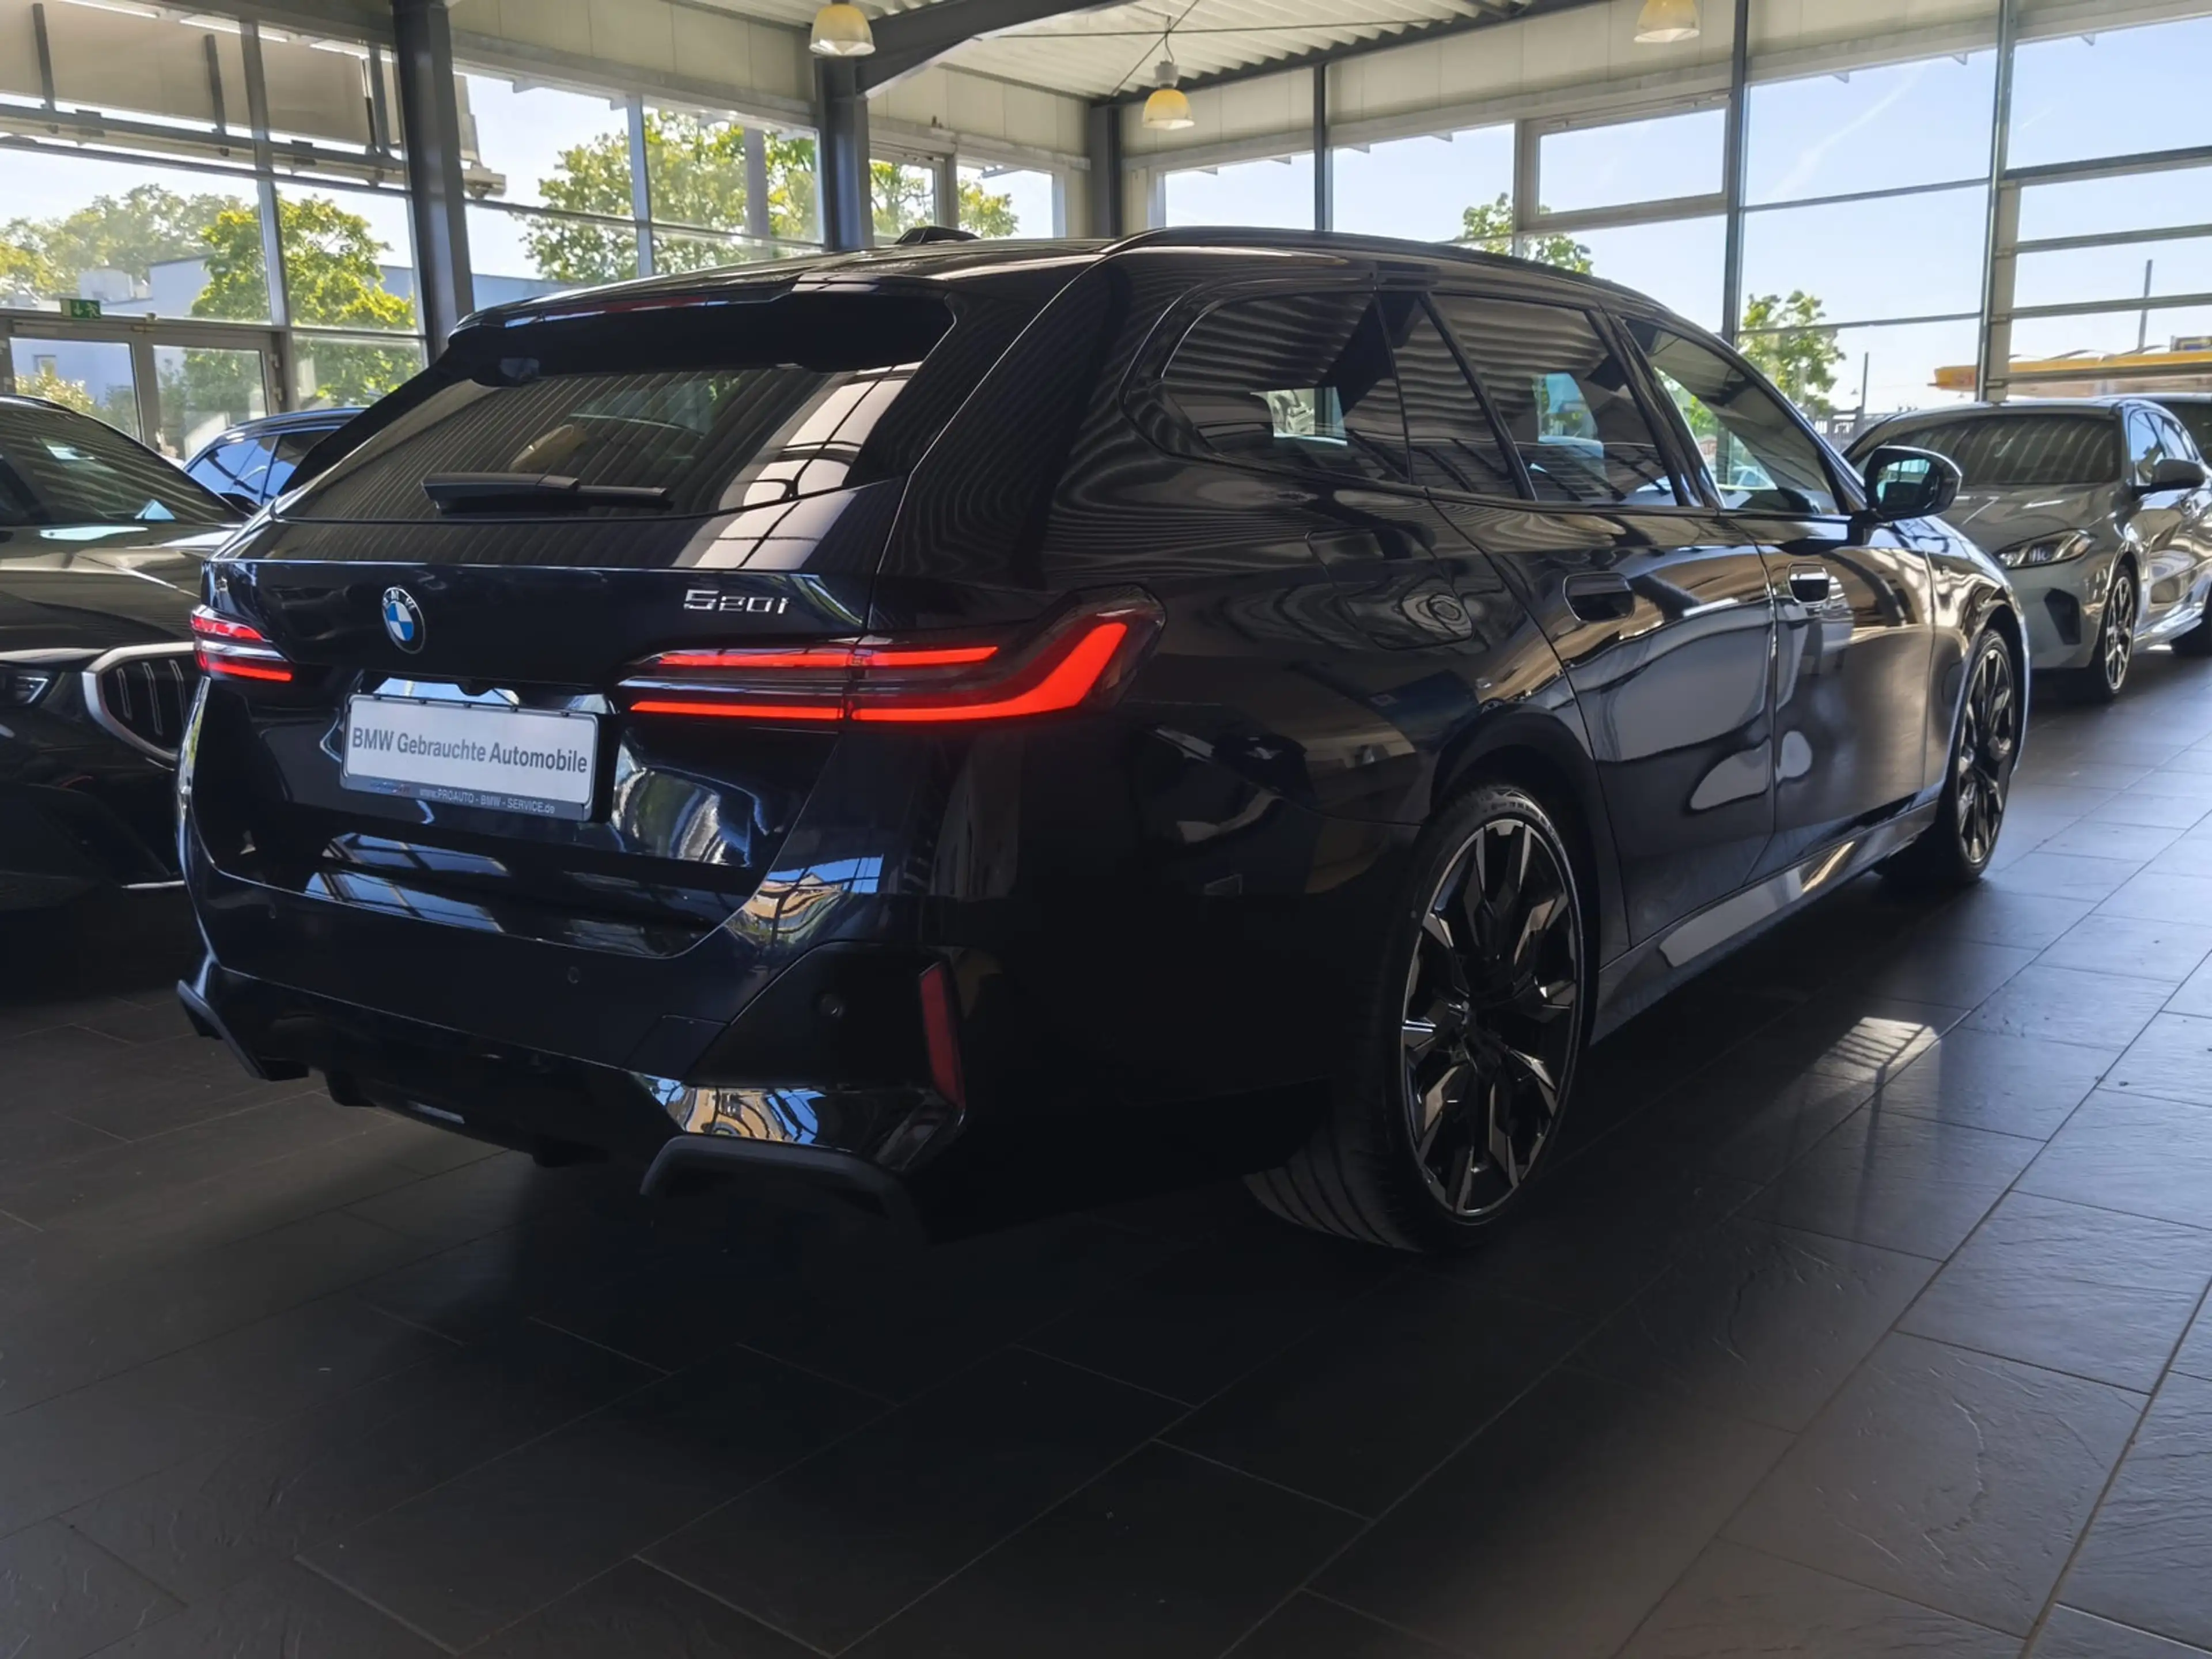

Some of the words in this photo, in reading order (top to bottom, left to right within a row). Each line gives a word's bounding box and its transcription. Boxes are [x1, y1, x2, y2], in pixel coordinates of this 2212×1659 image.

[683, 589, 789, 615] 520i
[352, 727, 395, 752] BMW
[397, 732, 486, 762] Gebrauchte
[489, 741, 587, 773] Automobile
[480, 794, 501, 807] BMW
